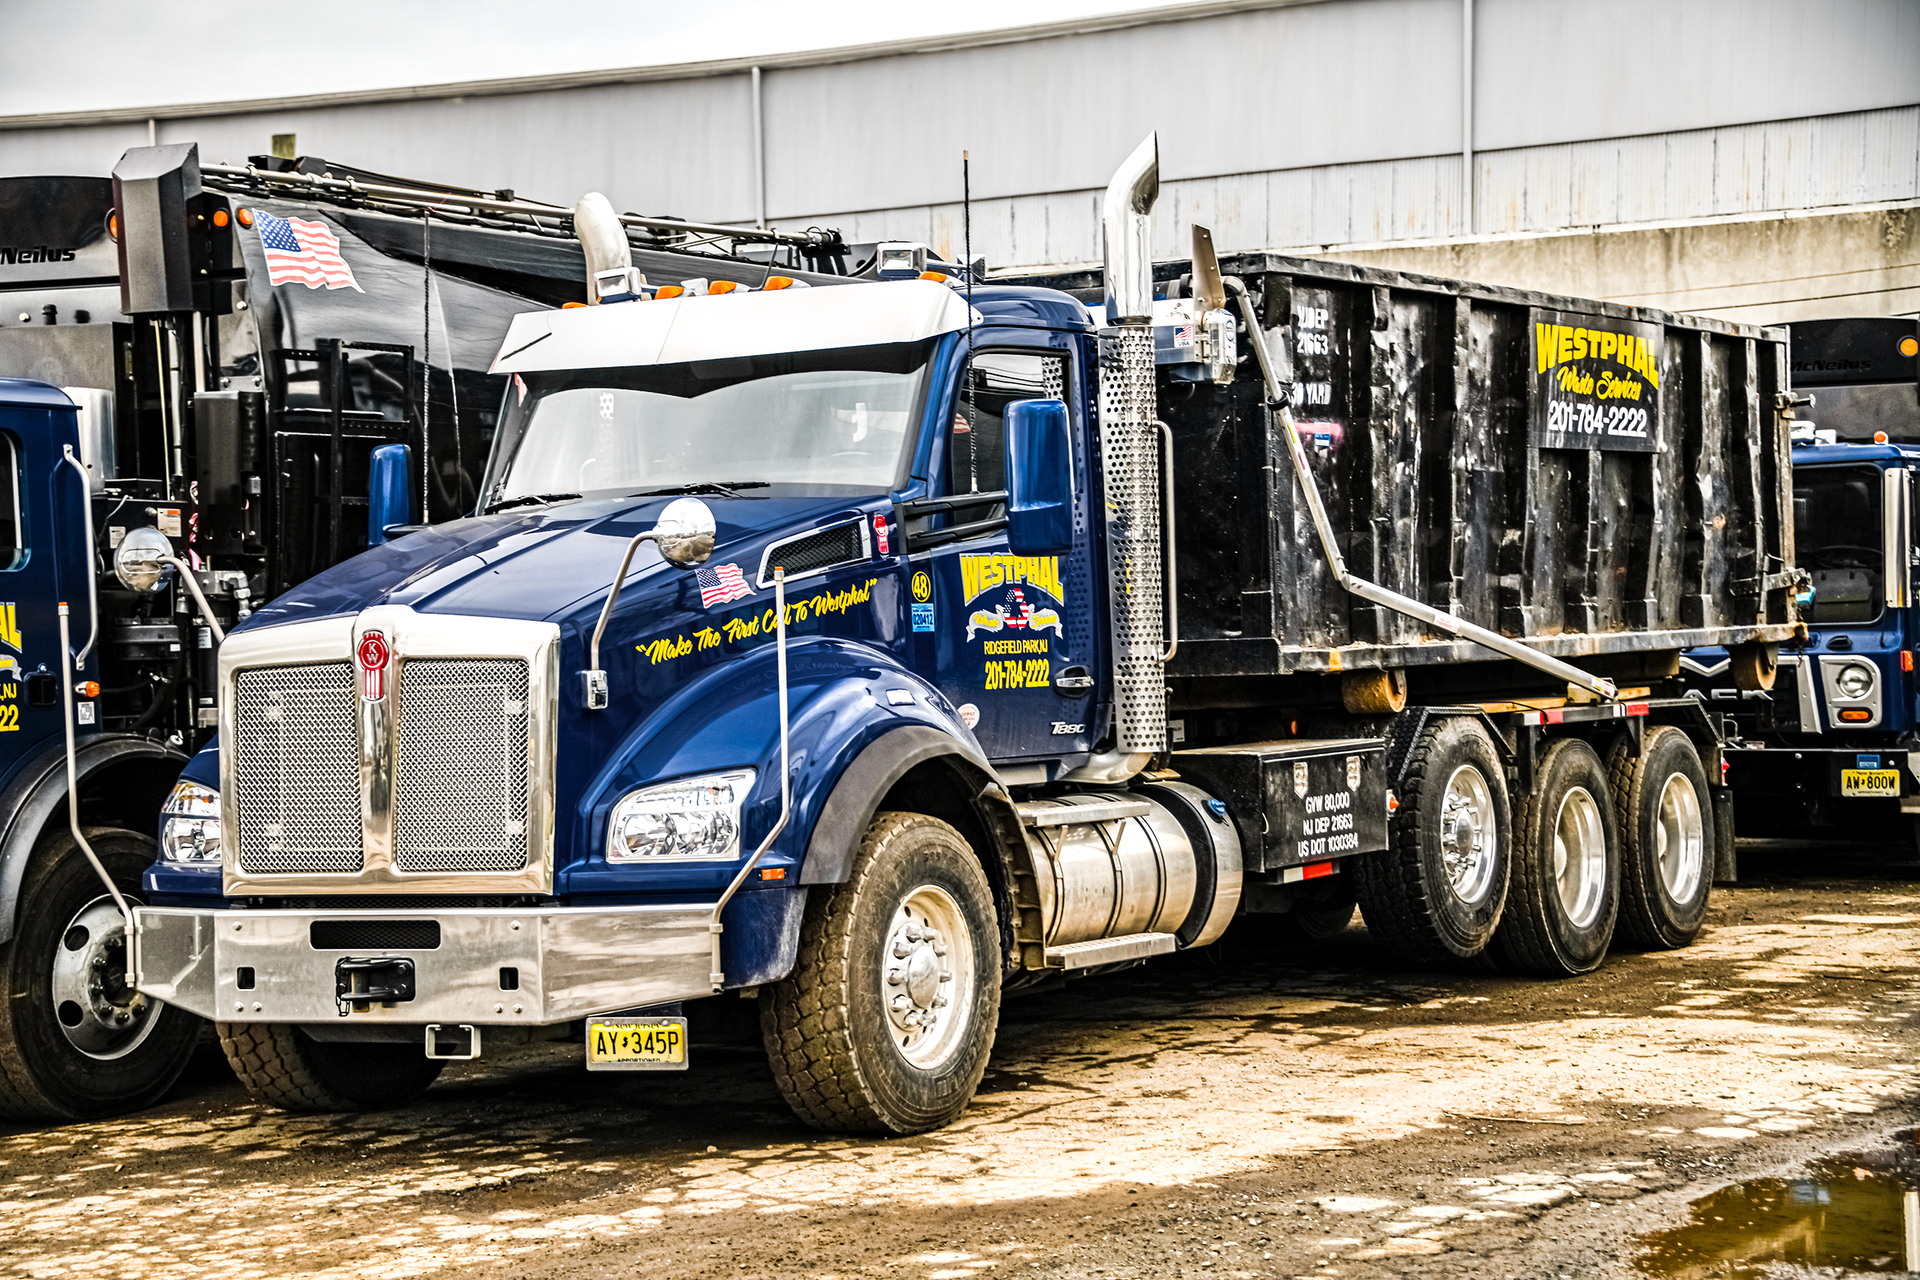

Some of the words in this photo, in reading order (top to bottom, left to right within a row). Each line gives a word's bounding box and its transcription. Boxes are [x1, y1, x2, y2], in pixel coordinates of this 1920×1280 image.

[1536, 322, 1659, 391] WESTPHAL
[1556, 365, 1594, 395] Waste
[1596, 371, 1642, 401] Services
[1548, 400, 1647, 438] 201-784-2222
[913, 575, 928, 598] 48
[959, 552, 1064, 607] WESTPHAL
[692, 626, 721, 652] The
[722, 615, 760, 643] First
[791, 600, 810, 623] To
[984, 640, 1022, 655] RIDGEFIELD
[985, 658, 1050, 690] 201-784-2222
[1051, 721, 1086, 735] T880
[1306, 795, 1324, 814] GVW
[1324, 791, 1350, 813] 80,000
[1303, 820, 1314, 836] NJ
[1315, 816, 1330, 834] DEP
[1331, 813, 1353, 832] 21663
[1297, 840, 1310, 857] US
[1310, 836, 1327, 856] DOT
[1327, 832, 1359, 852] 1030384
